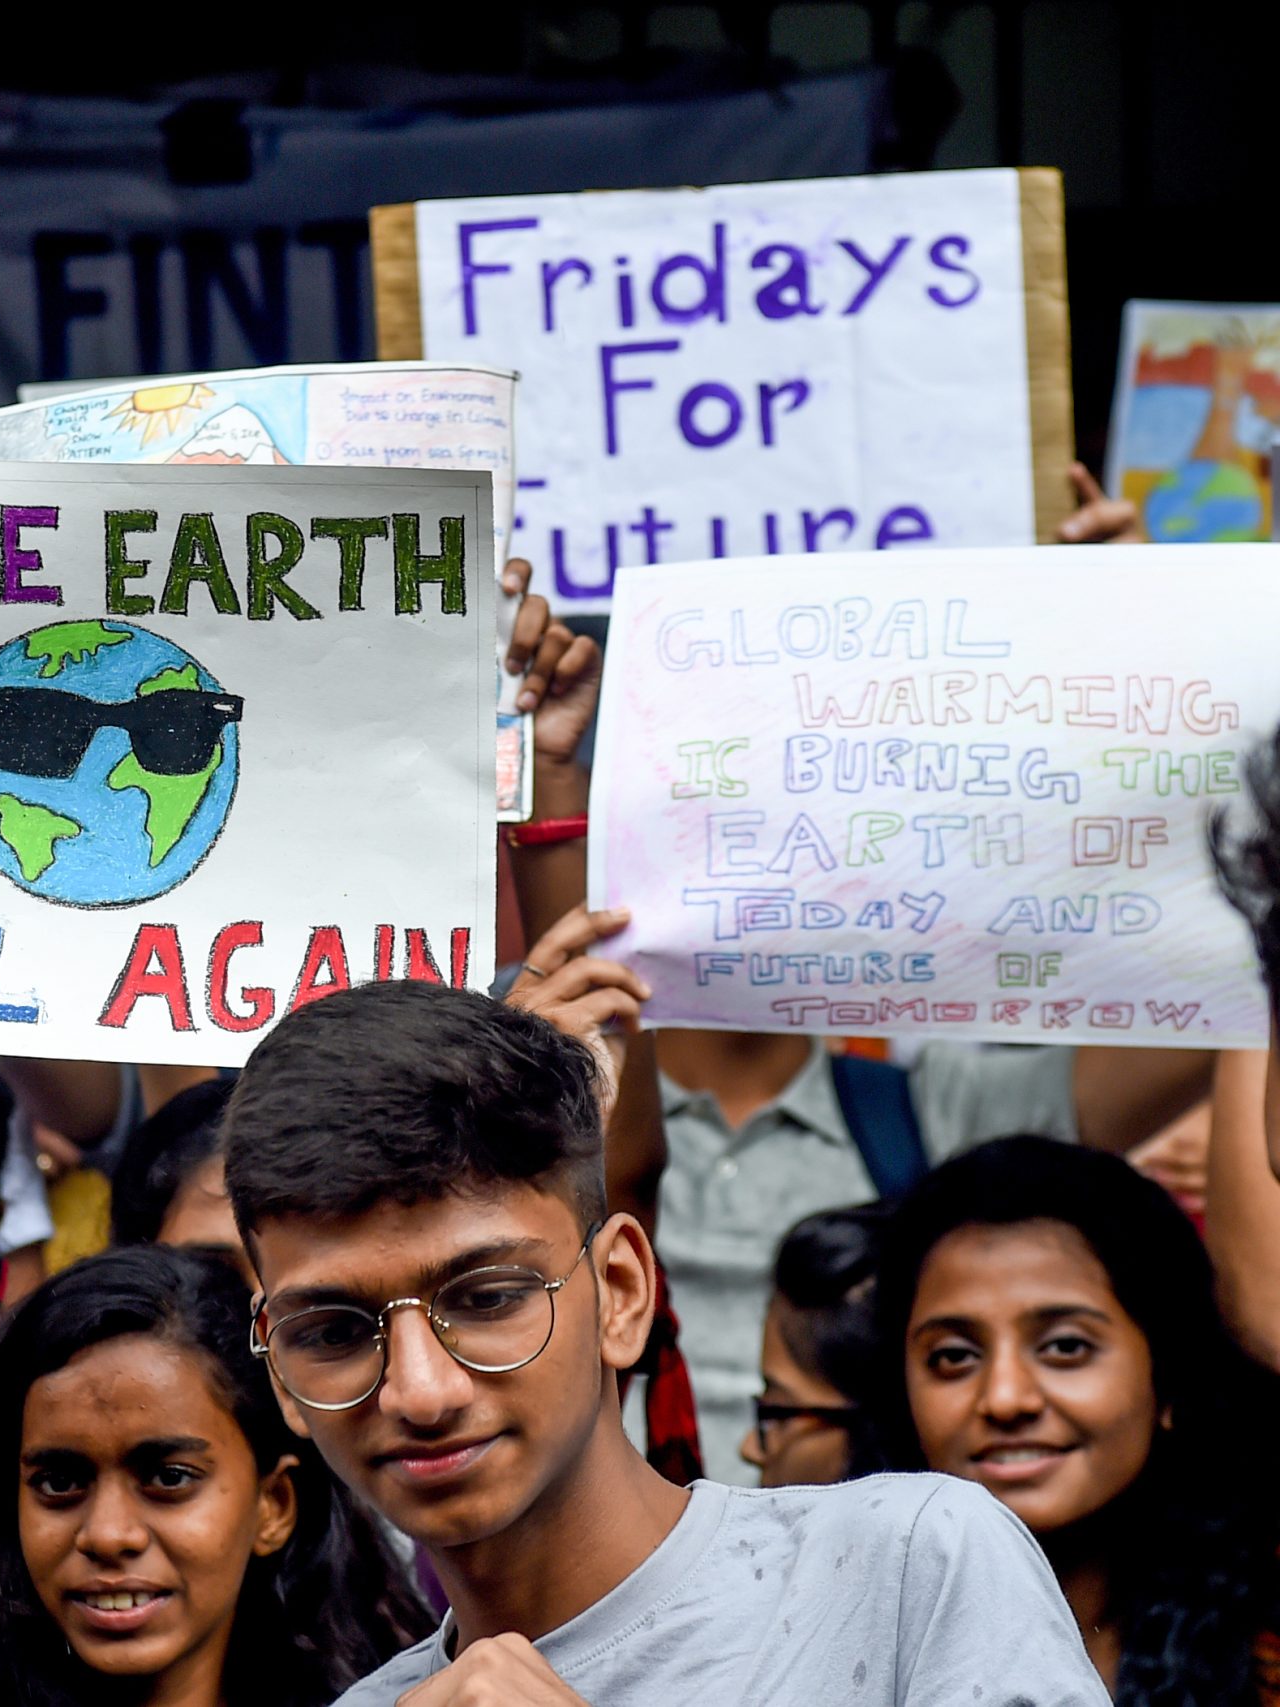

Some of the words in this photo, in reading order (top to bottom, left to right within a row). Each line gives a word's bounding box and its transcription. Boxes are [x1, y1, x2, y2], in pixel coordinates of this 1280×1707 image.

[457, 217, 982, 336] Fridays
[601, 339, 811, 456] For
[104, 510, 467, 622] EARTH
[515, 478, 936, 598] uture
[656, 597, 1011, 672] GLOBAL
[793, 670, 1240, 736] WARMING
[671, 737, 751, 799] IS
[783, 733, 1081, 805] BURNIG
[1103, 747, 1242, 797] THE
[705, 810, 1022, 878] EARTH
[1073, 816, 1170, 869] OF
[682, 887, 947, 941] TODAY
[987, 892, 1162, 936] AND
[693, 951, 936, 986] FUTURE
[997, 951, 1063, 989] OF
[771, 998, 1212, 1030] TOMORROW.
